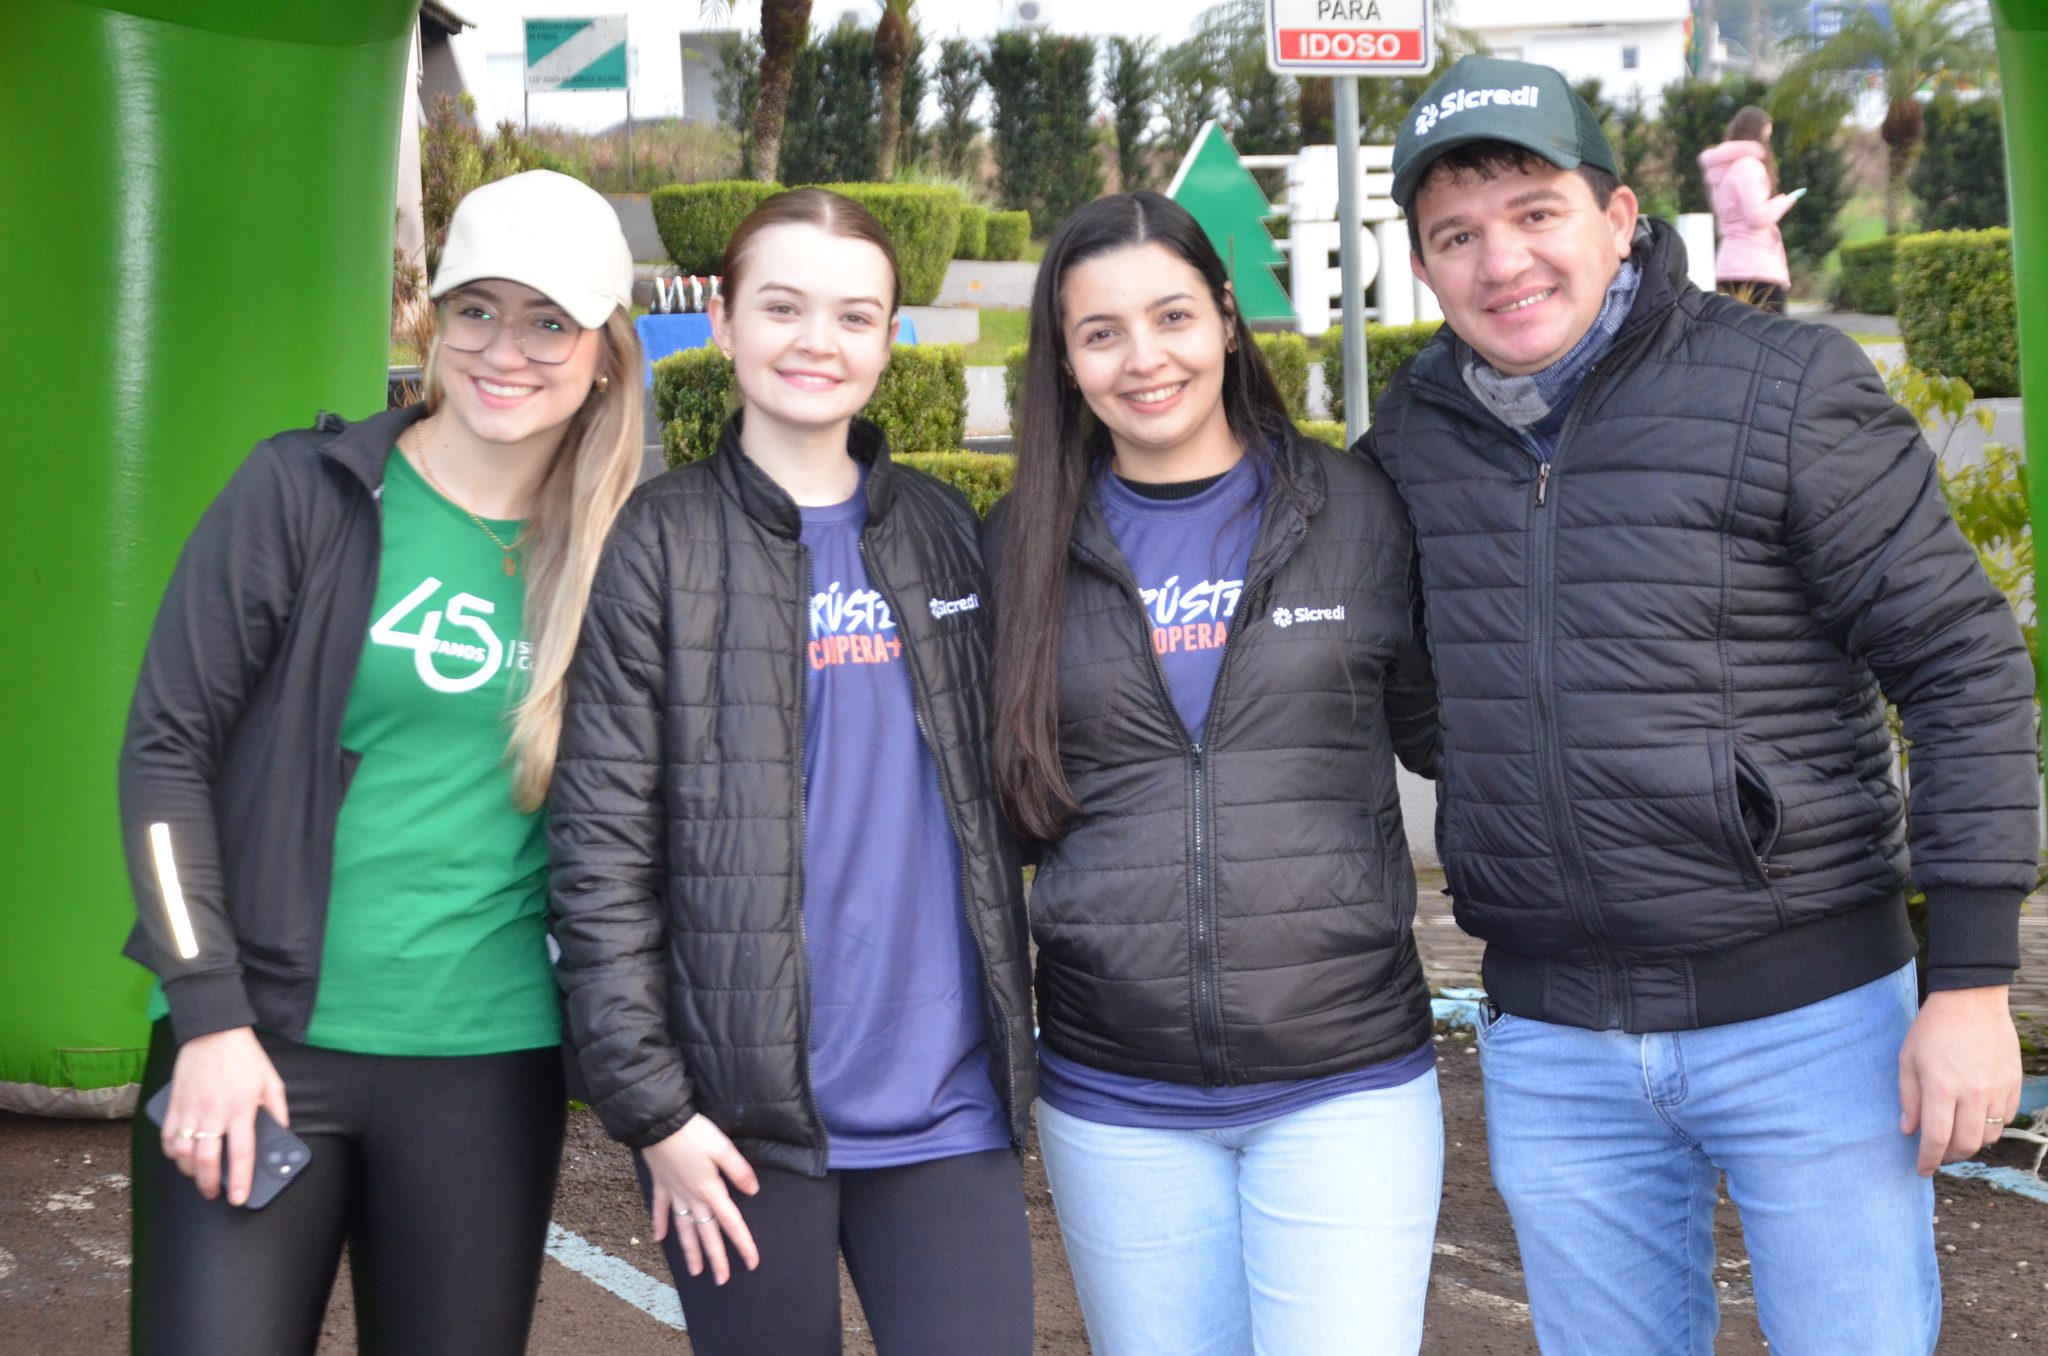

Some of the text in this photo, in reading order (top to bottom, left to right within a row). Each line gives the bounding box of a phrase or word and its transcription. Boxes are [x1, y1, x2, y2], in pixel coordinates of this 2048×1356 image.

[1317, 0, 1382, 21] PARA
[1299, 32, 1401, 58] IDOSO
[1439, 85, 1539, 120] Sicredi
[1294, 605, 1345, 622] Sicredi
[370, 577, 503, 693] 45
